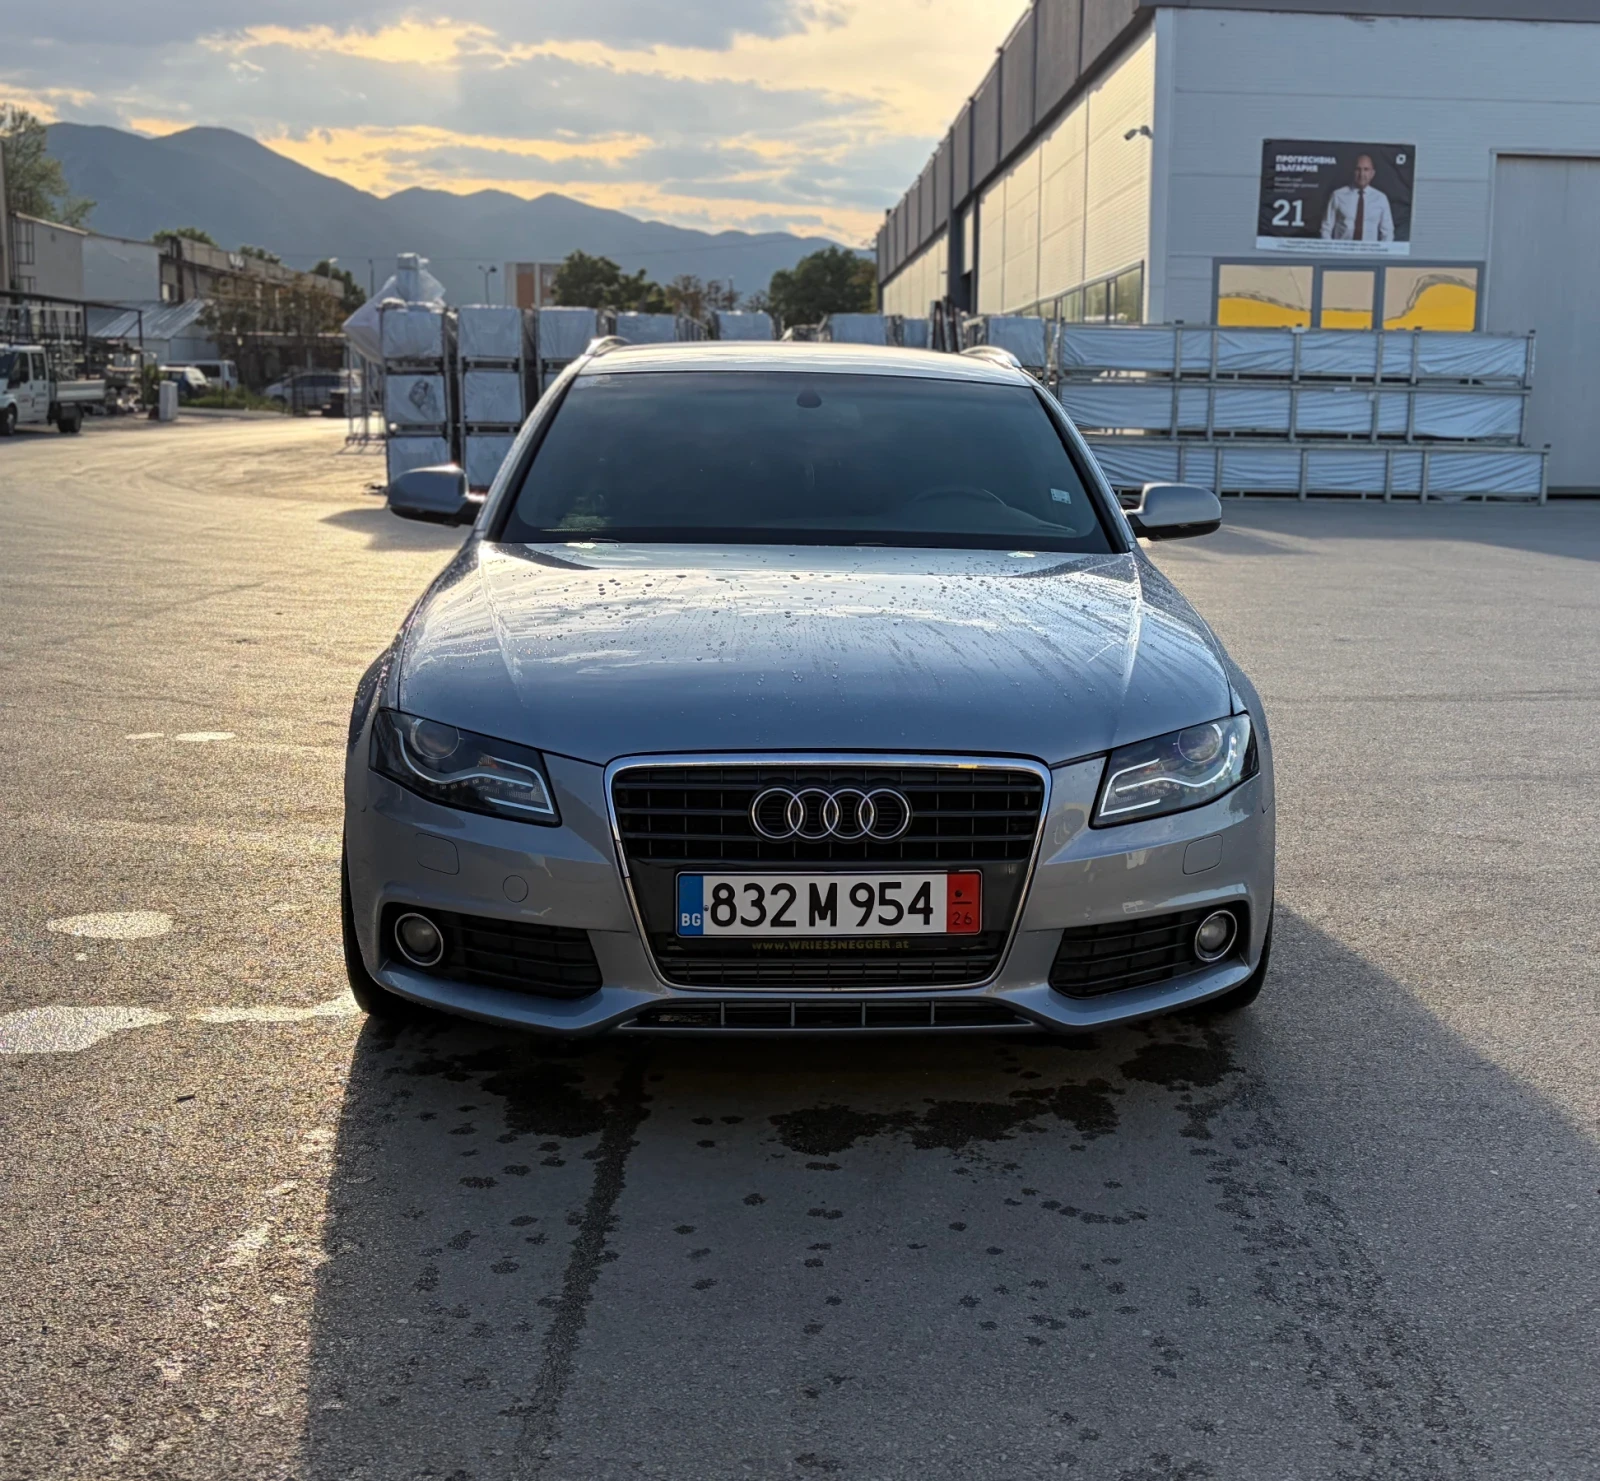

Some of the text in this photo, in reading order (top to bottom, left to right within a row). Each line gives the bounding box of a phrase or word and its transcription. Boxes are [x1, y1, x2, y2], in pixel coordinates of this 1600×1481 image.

[1275, 154, 1337, 165] ПРОГРЕСИВНА
[1275, 163, 1319, 173] БЪЛГАРИЯ
[1271, 198, 1306, 228] 21
[710, 881, 934, 928] 832 M 954
[681, 912, 702, 928] BG
[952, 911, 973, 926] 26
